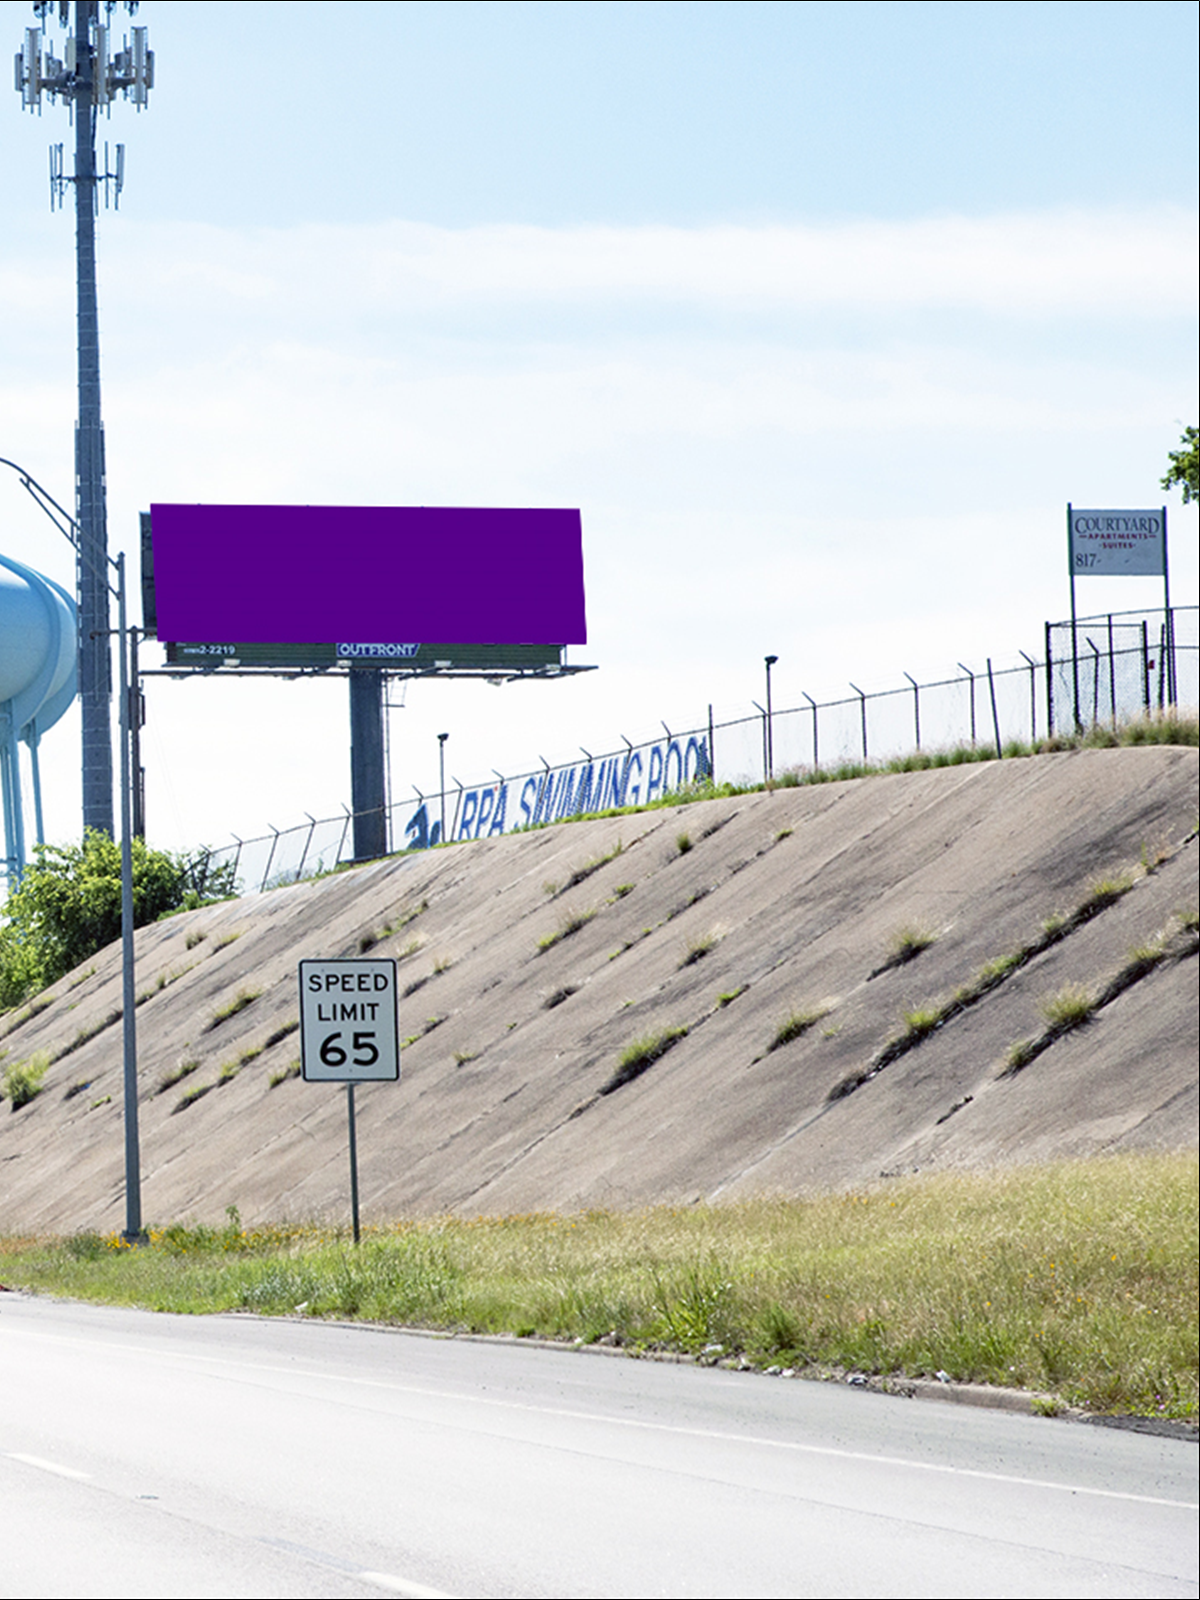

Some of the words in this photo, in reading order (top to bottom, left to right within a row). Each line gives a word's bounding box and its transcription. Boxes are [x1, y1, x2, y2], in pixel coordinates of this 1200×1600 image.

[1075, 517, 1160, 534] COURTYARD
[340, 643, 416, 655] OUTFRONT
[458, 783, 508, 840] RPA
[519, 750, 642, 830] SWIMMING
[308, 973, 388, 992] SPEED
[318, 1003, 379, 1021] LIMIT
[320, 1031, 379, 1067] 65
